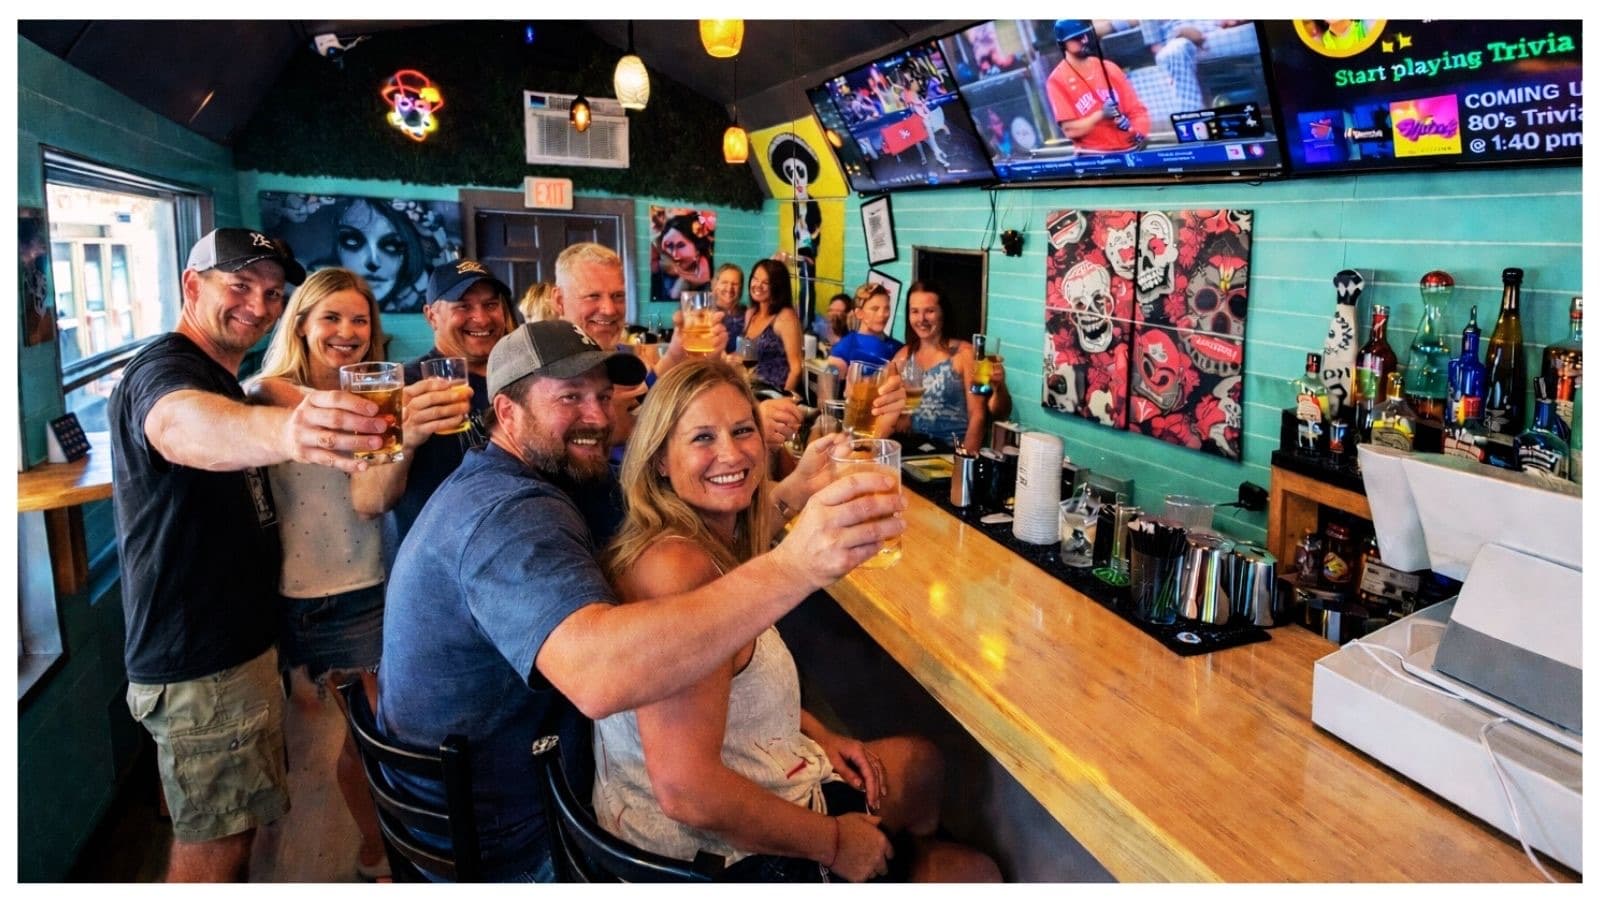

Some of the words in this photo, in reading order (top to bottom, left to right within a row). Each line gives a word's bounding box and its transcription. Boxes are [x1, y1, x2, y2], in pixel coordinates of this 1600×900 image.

[1334, 66, 1386, 87] Start
[1391, 50, 1483, 81] playing
[1487, 33, 1575, 62] Trivia
[1465, 84, 1560, 108] COMING
[1467, 113, 1517, 132] 80's
[1470, 138, 1486, 153] @
[1491, 132, 1539, 151] 1:40
[1545, 132, 1583, 151] pm
[535, 181, 567, 206] EXIT
